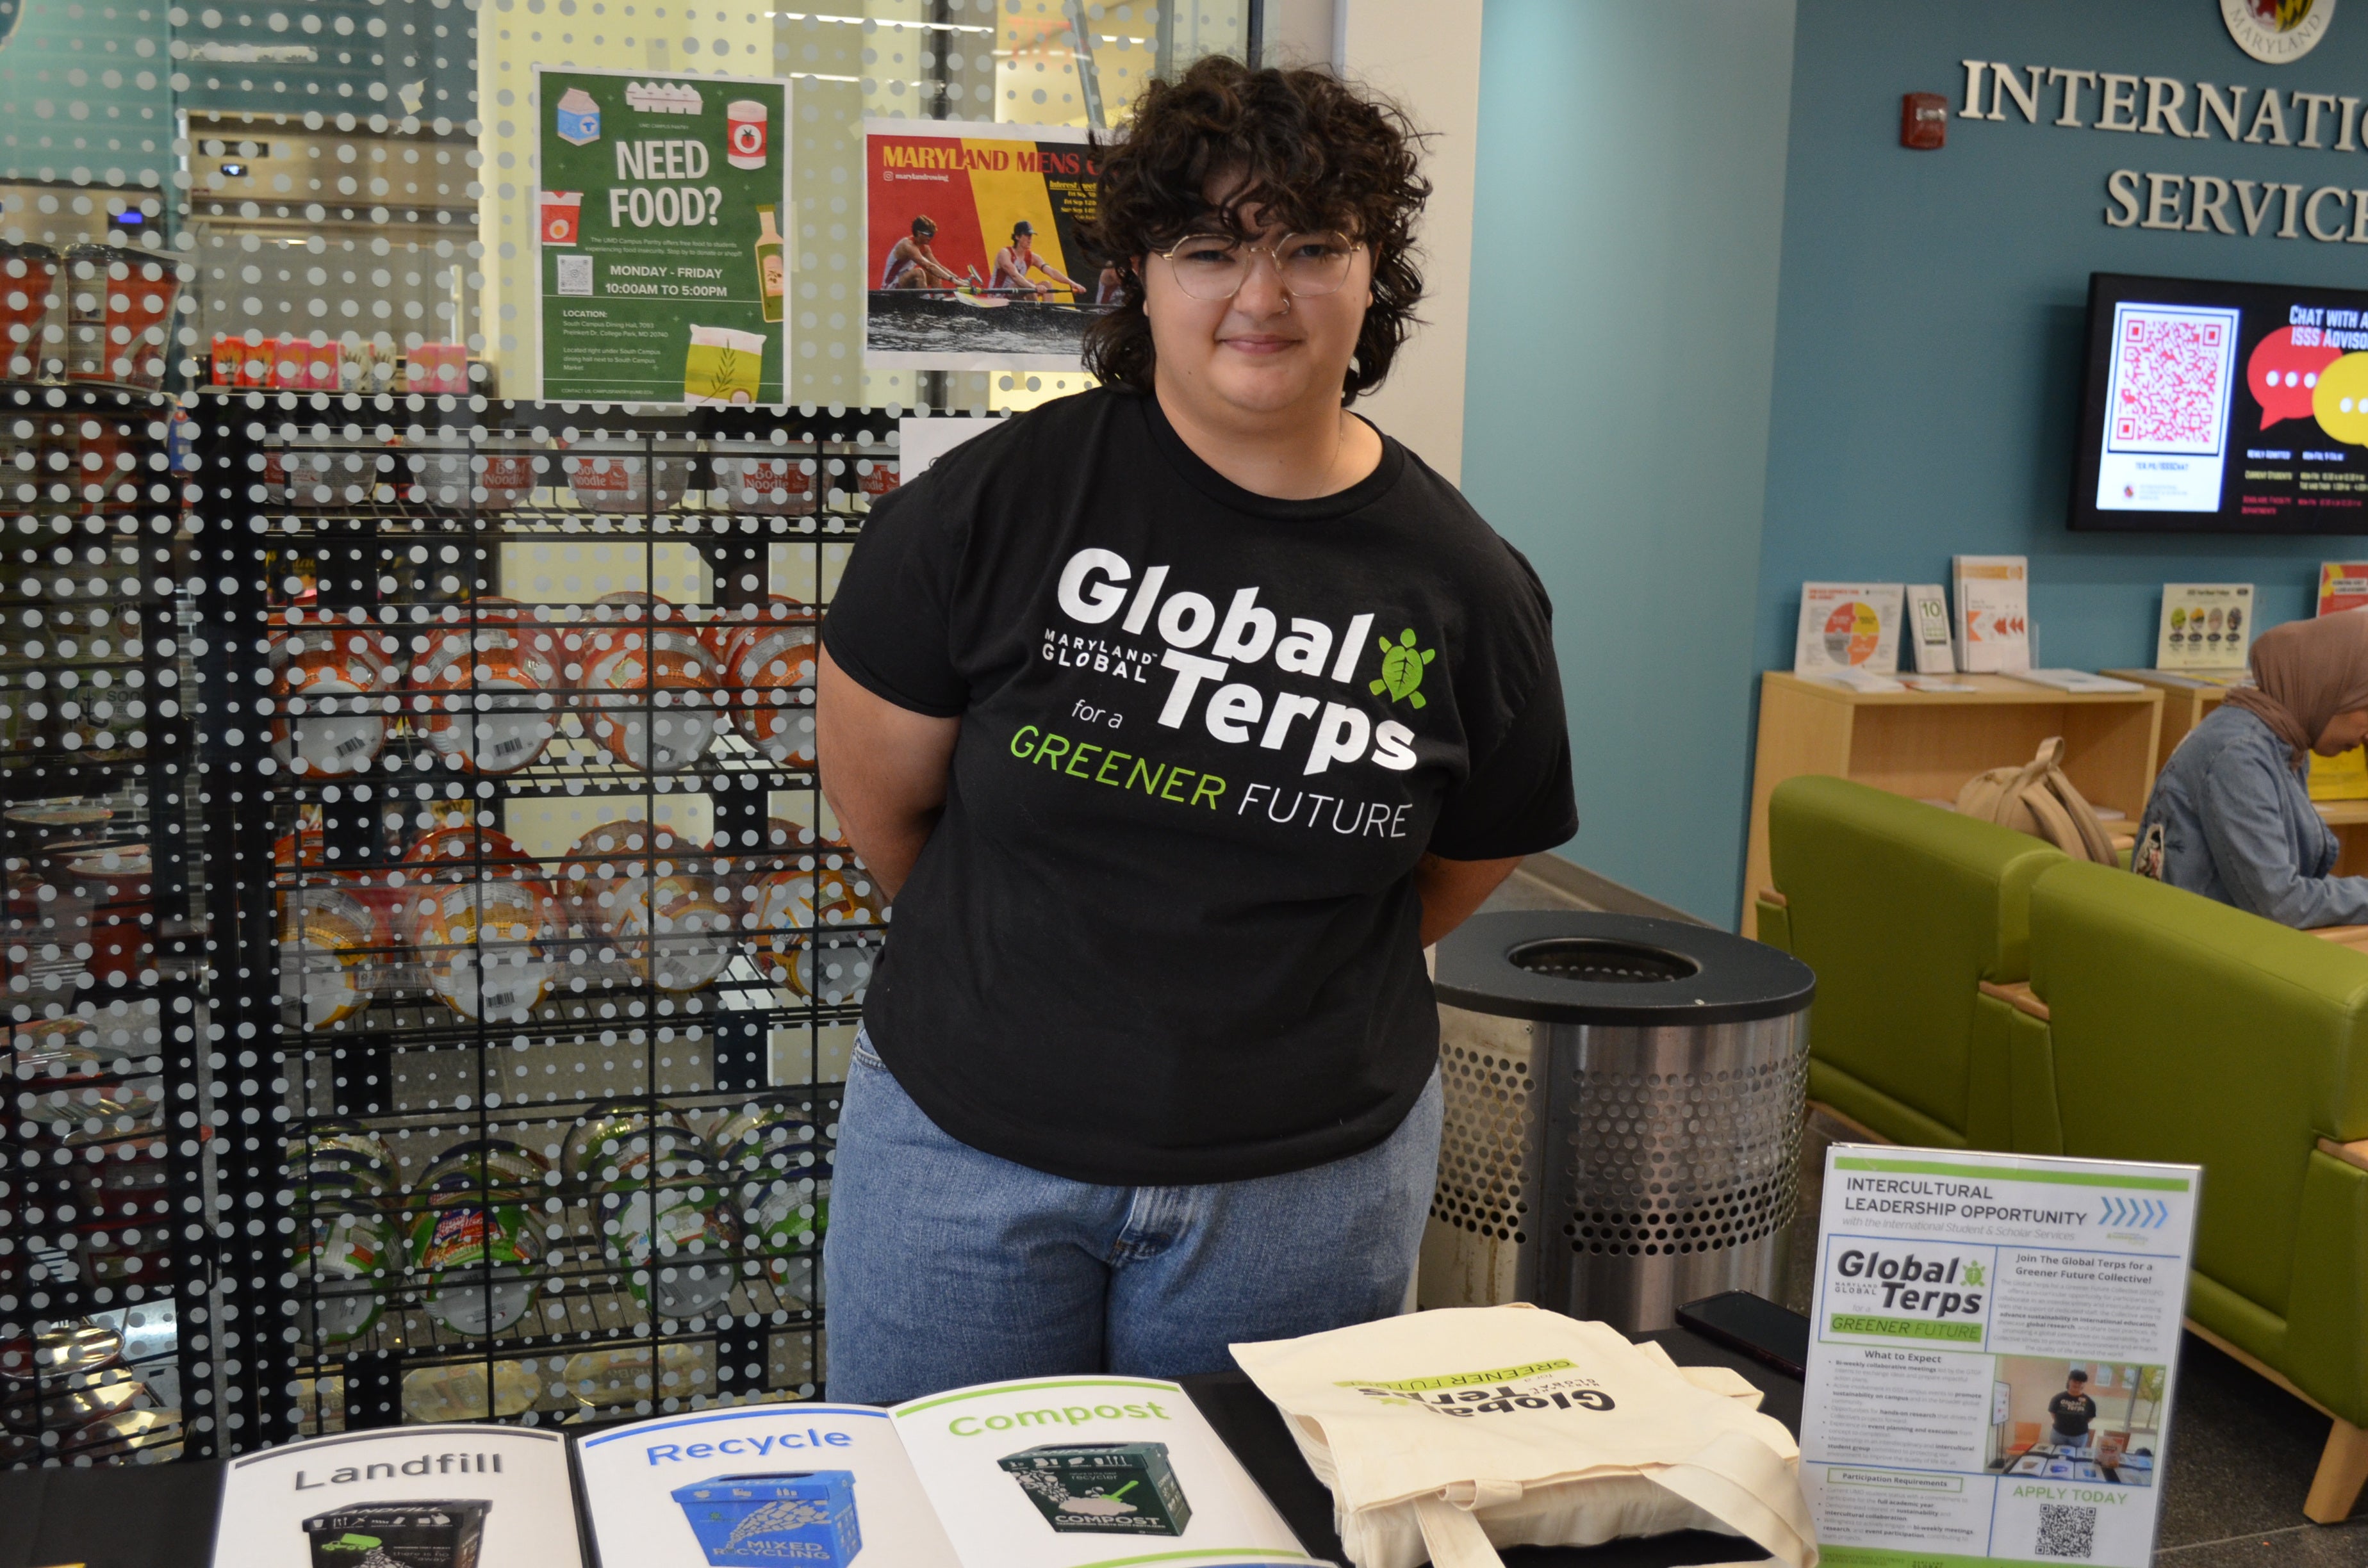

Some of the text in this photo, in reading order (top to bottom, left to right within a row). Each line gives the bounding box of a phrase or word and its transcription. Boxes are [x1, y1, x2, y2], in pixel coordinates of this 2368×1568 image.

[2230, 8, 2320, 54] MARYLAND
[1958, 60, 2368, 152] INTERNATI
[615, 140, 709, 180] NEED
[883, 145, 1009, 172] MARYLAND
[1017, 151, 1081, 174] MENS
[609, 186, 723, 227] FOOD?
[611, 265, 668, 277] MONDAY
[678, 268, 723, 279] FRIDAY
[605, 283, 727, 297] 10:00AM TO 5:00PM
[2289, 304, 2322, 327] CHAT
[2326, 307, 2358, 329] WITH
[2290, 327, 2319, 347] ISSS
[485, 475, 525, 485] Noodle
[745, 479, 789, 489] Noodle
[1057, 547, 1375, 684] Global
[1923, 602, 1941, 617] 10
[1041, 643, 1148, 683] GLOBAL
[1070, 698, 1123, 729] for a
[1156, 648, 1418, 776] Terps
[1010, 724, 1414, 838] GREENER FUTURE
[1846, 1177, 1993, 1200] INTERCULTURAL
[1845, 1196, 2088, 1226] LEADERSHIP OPPORTUNITY
[1842, 1217, 2076, 1241] with the International Student & Scholar Services
[1838, 1250, 1960, 1284] Global
[2016, 1254, 2037, 1263] Join
[2040, 1255, 2059, 1264] The
[2062, 1257, 2094, 1266] Global
[2097, 1259, 2126, 1270] Terps
[2129, 1262, 2143, 1270] for
[2016, 1267, 2152, 1284] Greener Future Collective!
[1835, 1287, 1877, 1295] GLOBAL
[1881, 1281, 1982, 1318] Terps
[1852, 1304, 1864, 1312] for
[2028, 1313, 2070, 1323] sustainability
[2080, 1317, 2123, 1325] international
[1832, 1318, 1981, 1339] GREENER FUTURE
[1836, 1360, 1865, 1368] Bi-weekly
[1866, 1362, 1906, 1370] collaborative
[1865, 1350, 1891, 1360] What
[1908, 1353, 1942, 1364] Expect
[1451, 1360, 1571, 1385] GREENER
[1529, 1378, 1595, 1392] GLOBAL
[1833, 1391, 1874, 1399] sustainability
[948, 1401, 1172, 1437] Compost
[1886, 1425, 1914, 1433] planning
[646, 1428, 853, 1466] Recycle
[1935, 1443, 1975, 1451] intercultural
[295, 1453, 503, 1490] Landfill
[1843, 1473, 1948, 1487] Participation Requirements
[2012, 1485, 2128, 1505] APPLY TODAY
[329, 1507, 442, 1515] LANDFILL
[1825, 1510, 1864, 1518] intercultural
[1896, 1507, 1939, 1516] sustainability
[1055, 1515, 1160, 1525] COMPOST
[1914, 1524, 1943, 1533] bi-weekly
[712, 1548, 831, 1560] RCYCLING
[746, 1540, 823, 1551] MIXED
